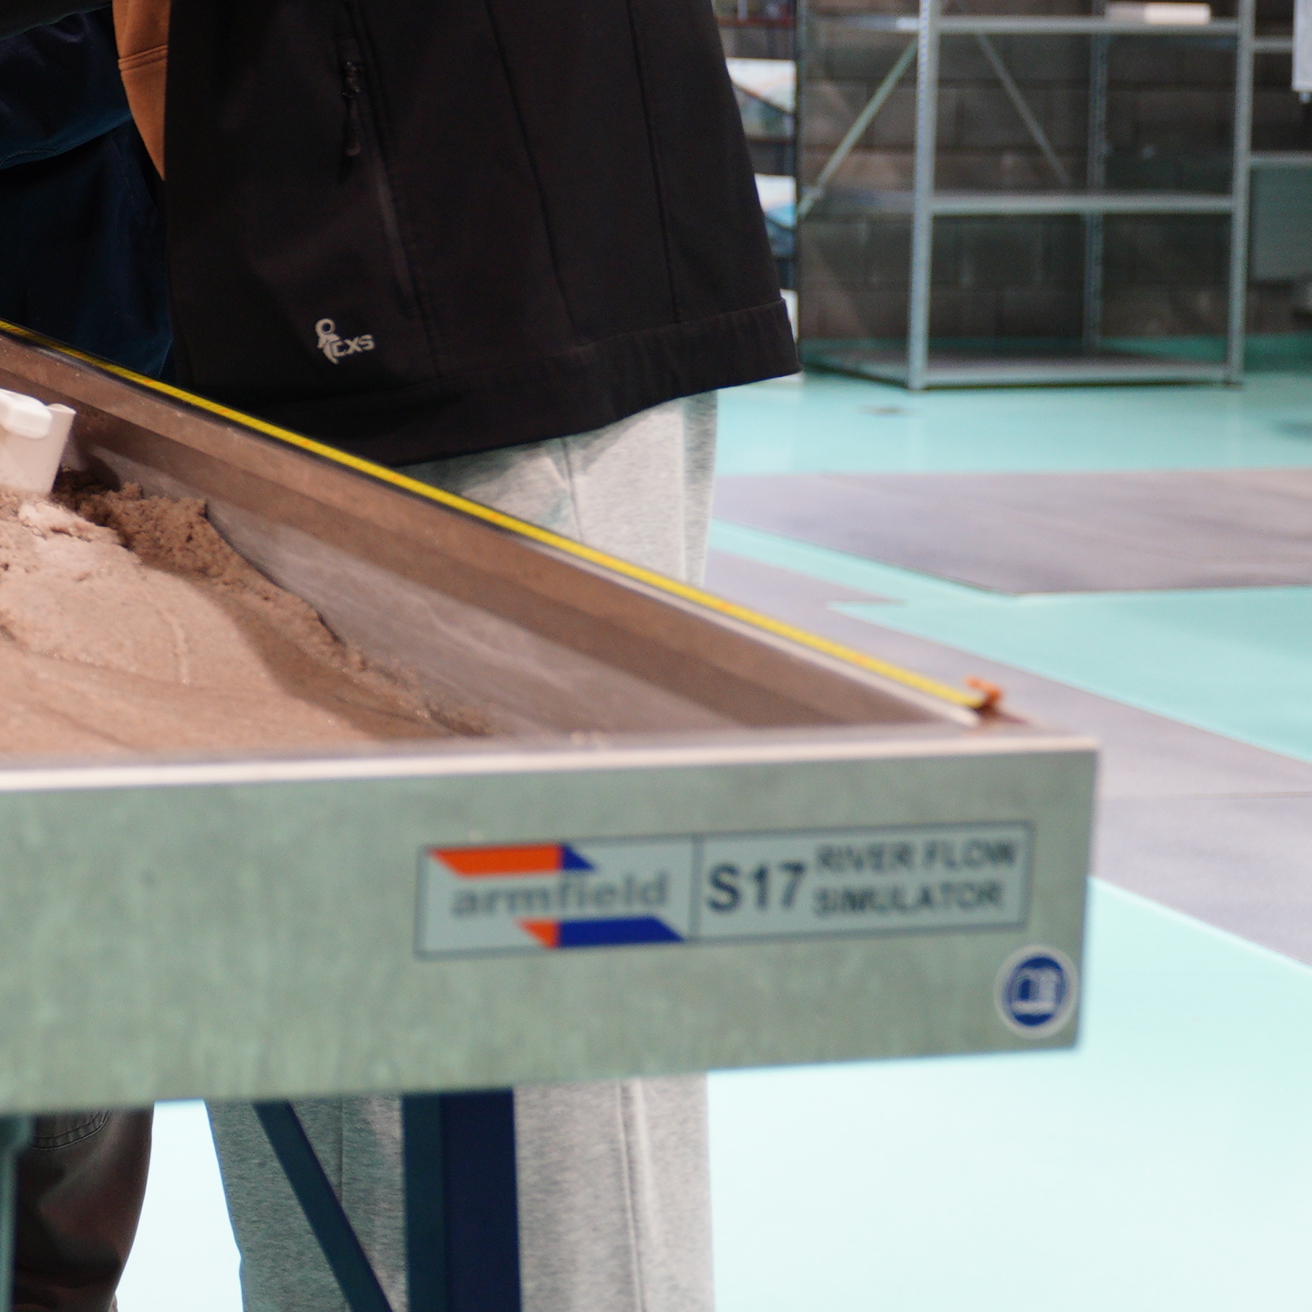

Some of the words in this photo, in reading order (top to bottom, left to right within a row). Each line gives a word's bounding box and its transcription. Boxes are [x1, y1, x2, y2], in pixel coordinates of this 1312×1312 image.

[814, 841, 916, 874] RIVER
[922, 838, 1015, 870] FLOW
[450, 870, 669, 918] armfield
[707, 860, 807, 913] S17
[814, 880, 1003, 916] SIMULATOR
